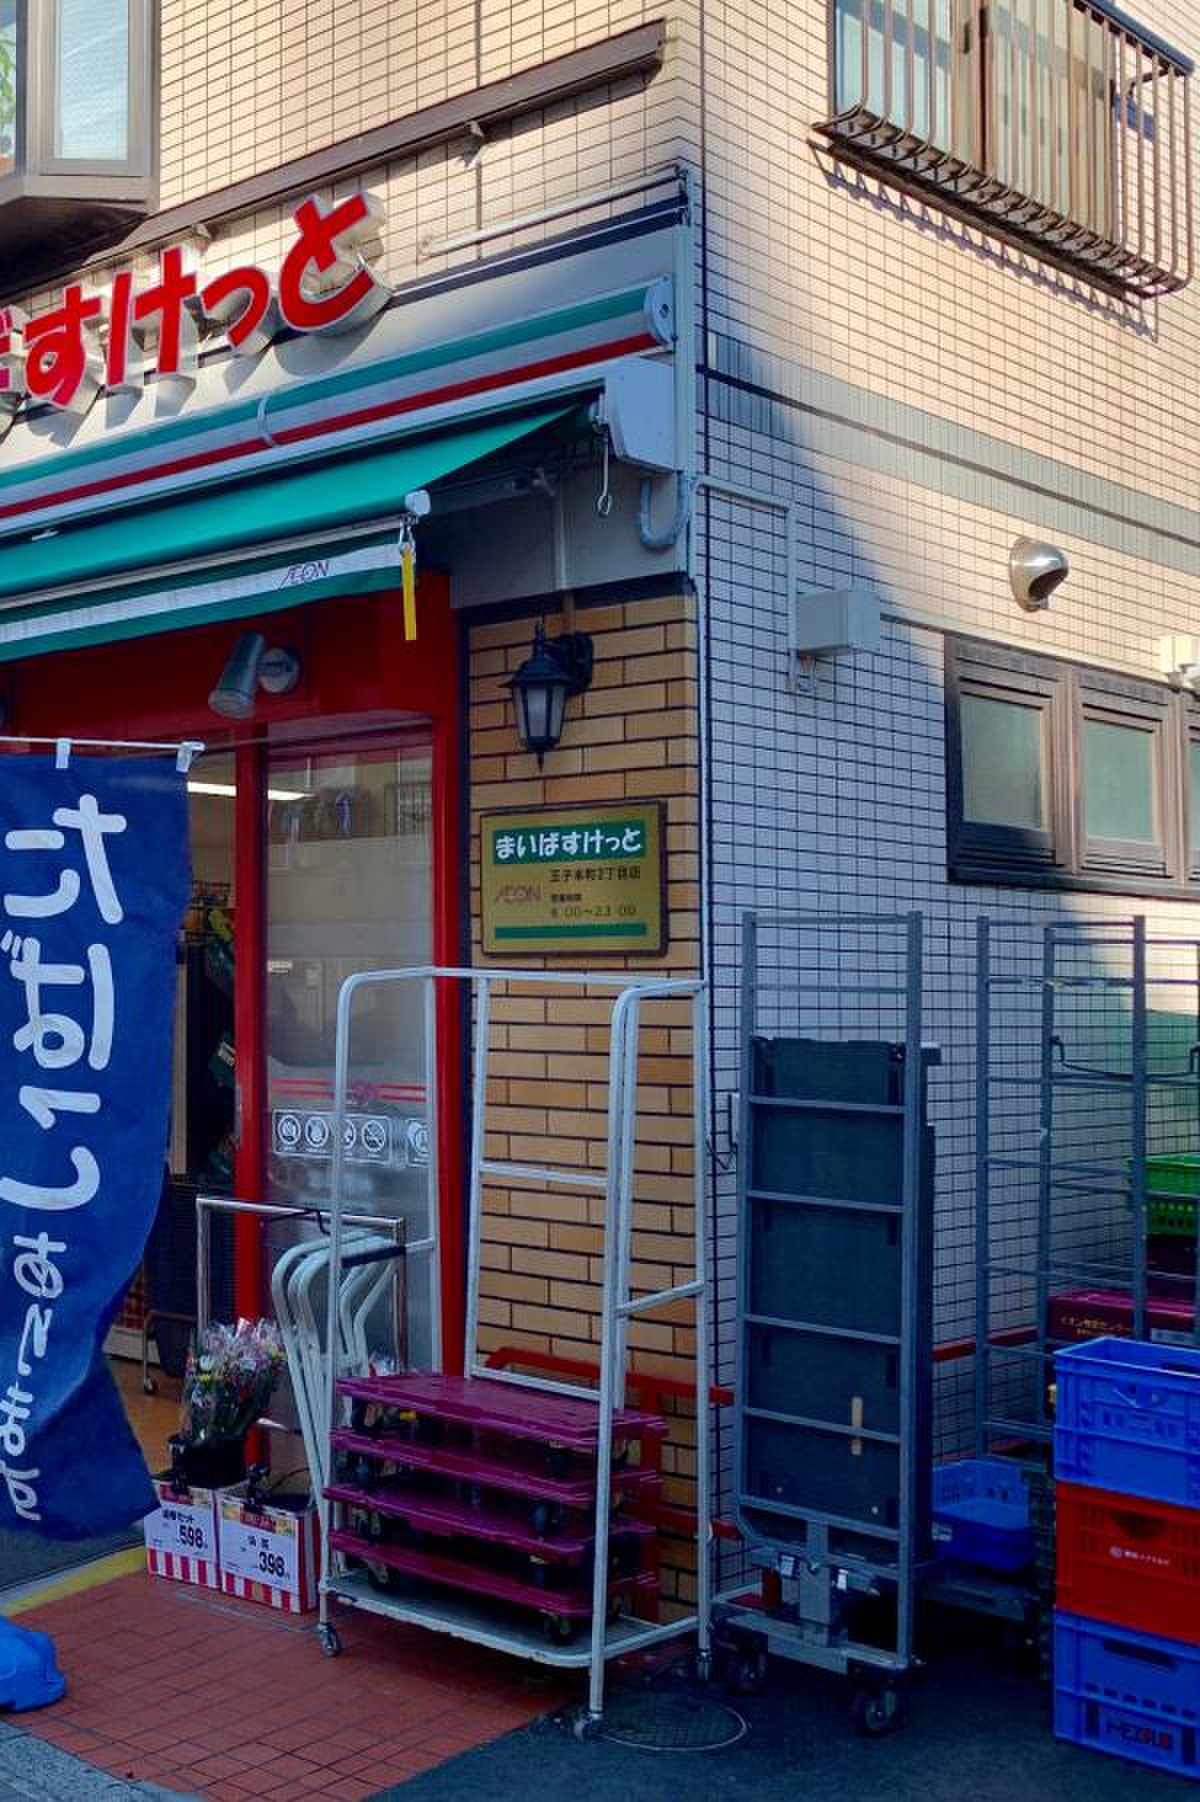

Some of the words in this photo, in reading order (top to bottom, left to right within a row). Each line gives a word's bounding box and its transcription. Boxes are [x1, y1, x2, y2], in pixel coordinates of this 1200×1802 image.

[495, 828, 641, 859] まいばすけっと
[178, 1525, 204, 1550] 598
[258, 1551, 286, 1577] 398
